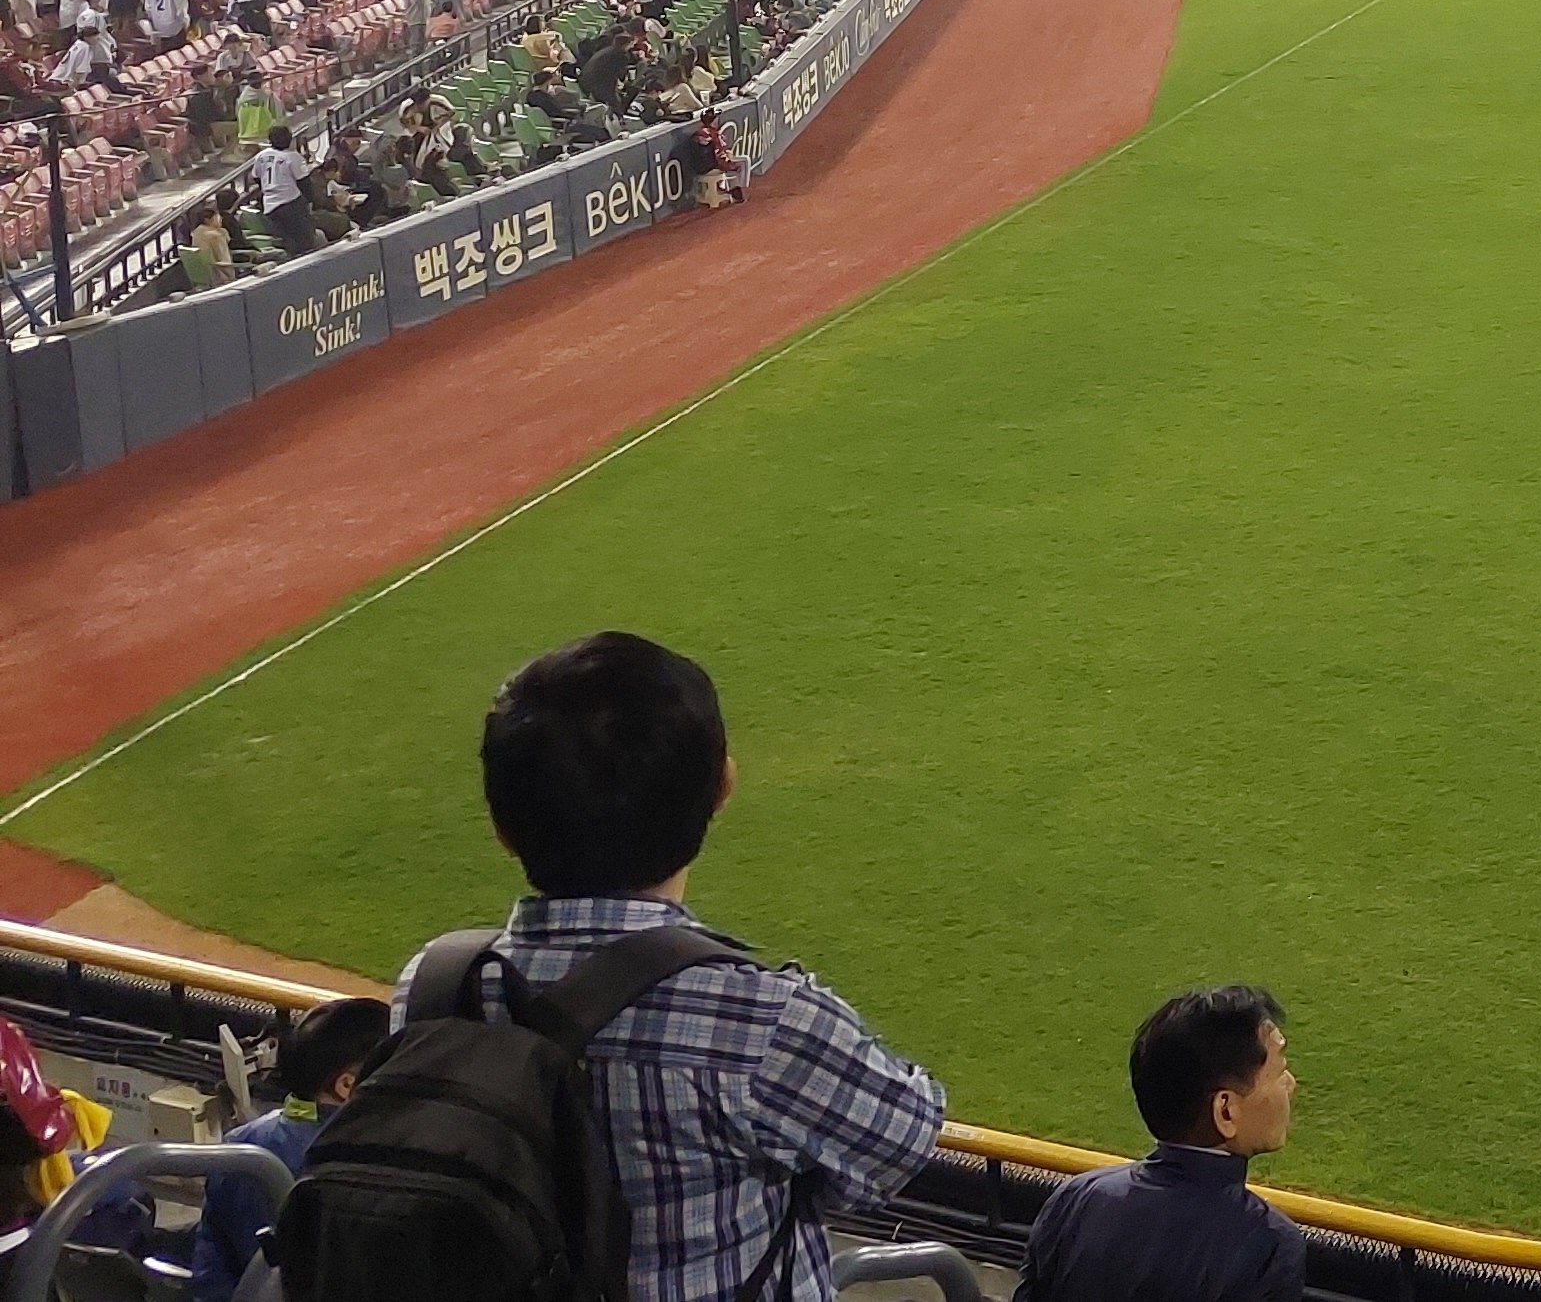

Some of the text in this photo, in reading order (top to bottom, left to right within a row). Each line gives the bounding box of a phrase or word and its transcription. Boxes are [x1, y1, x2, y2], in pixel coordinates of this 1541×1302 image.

[413, 200, 559, 301] 백조씽크
[278, 270, 386, 336] Only Think!
[314, 313, 363, 358] Sink!
